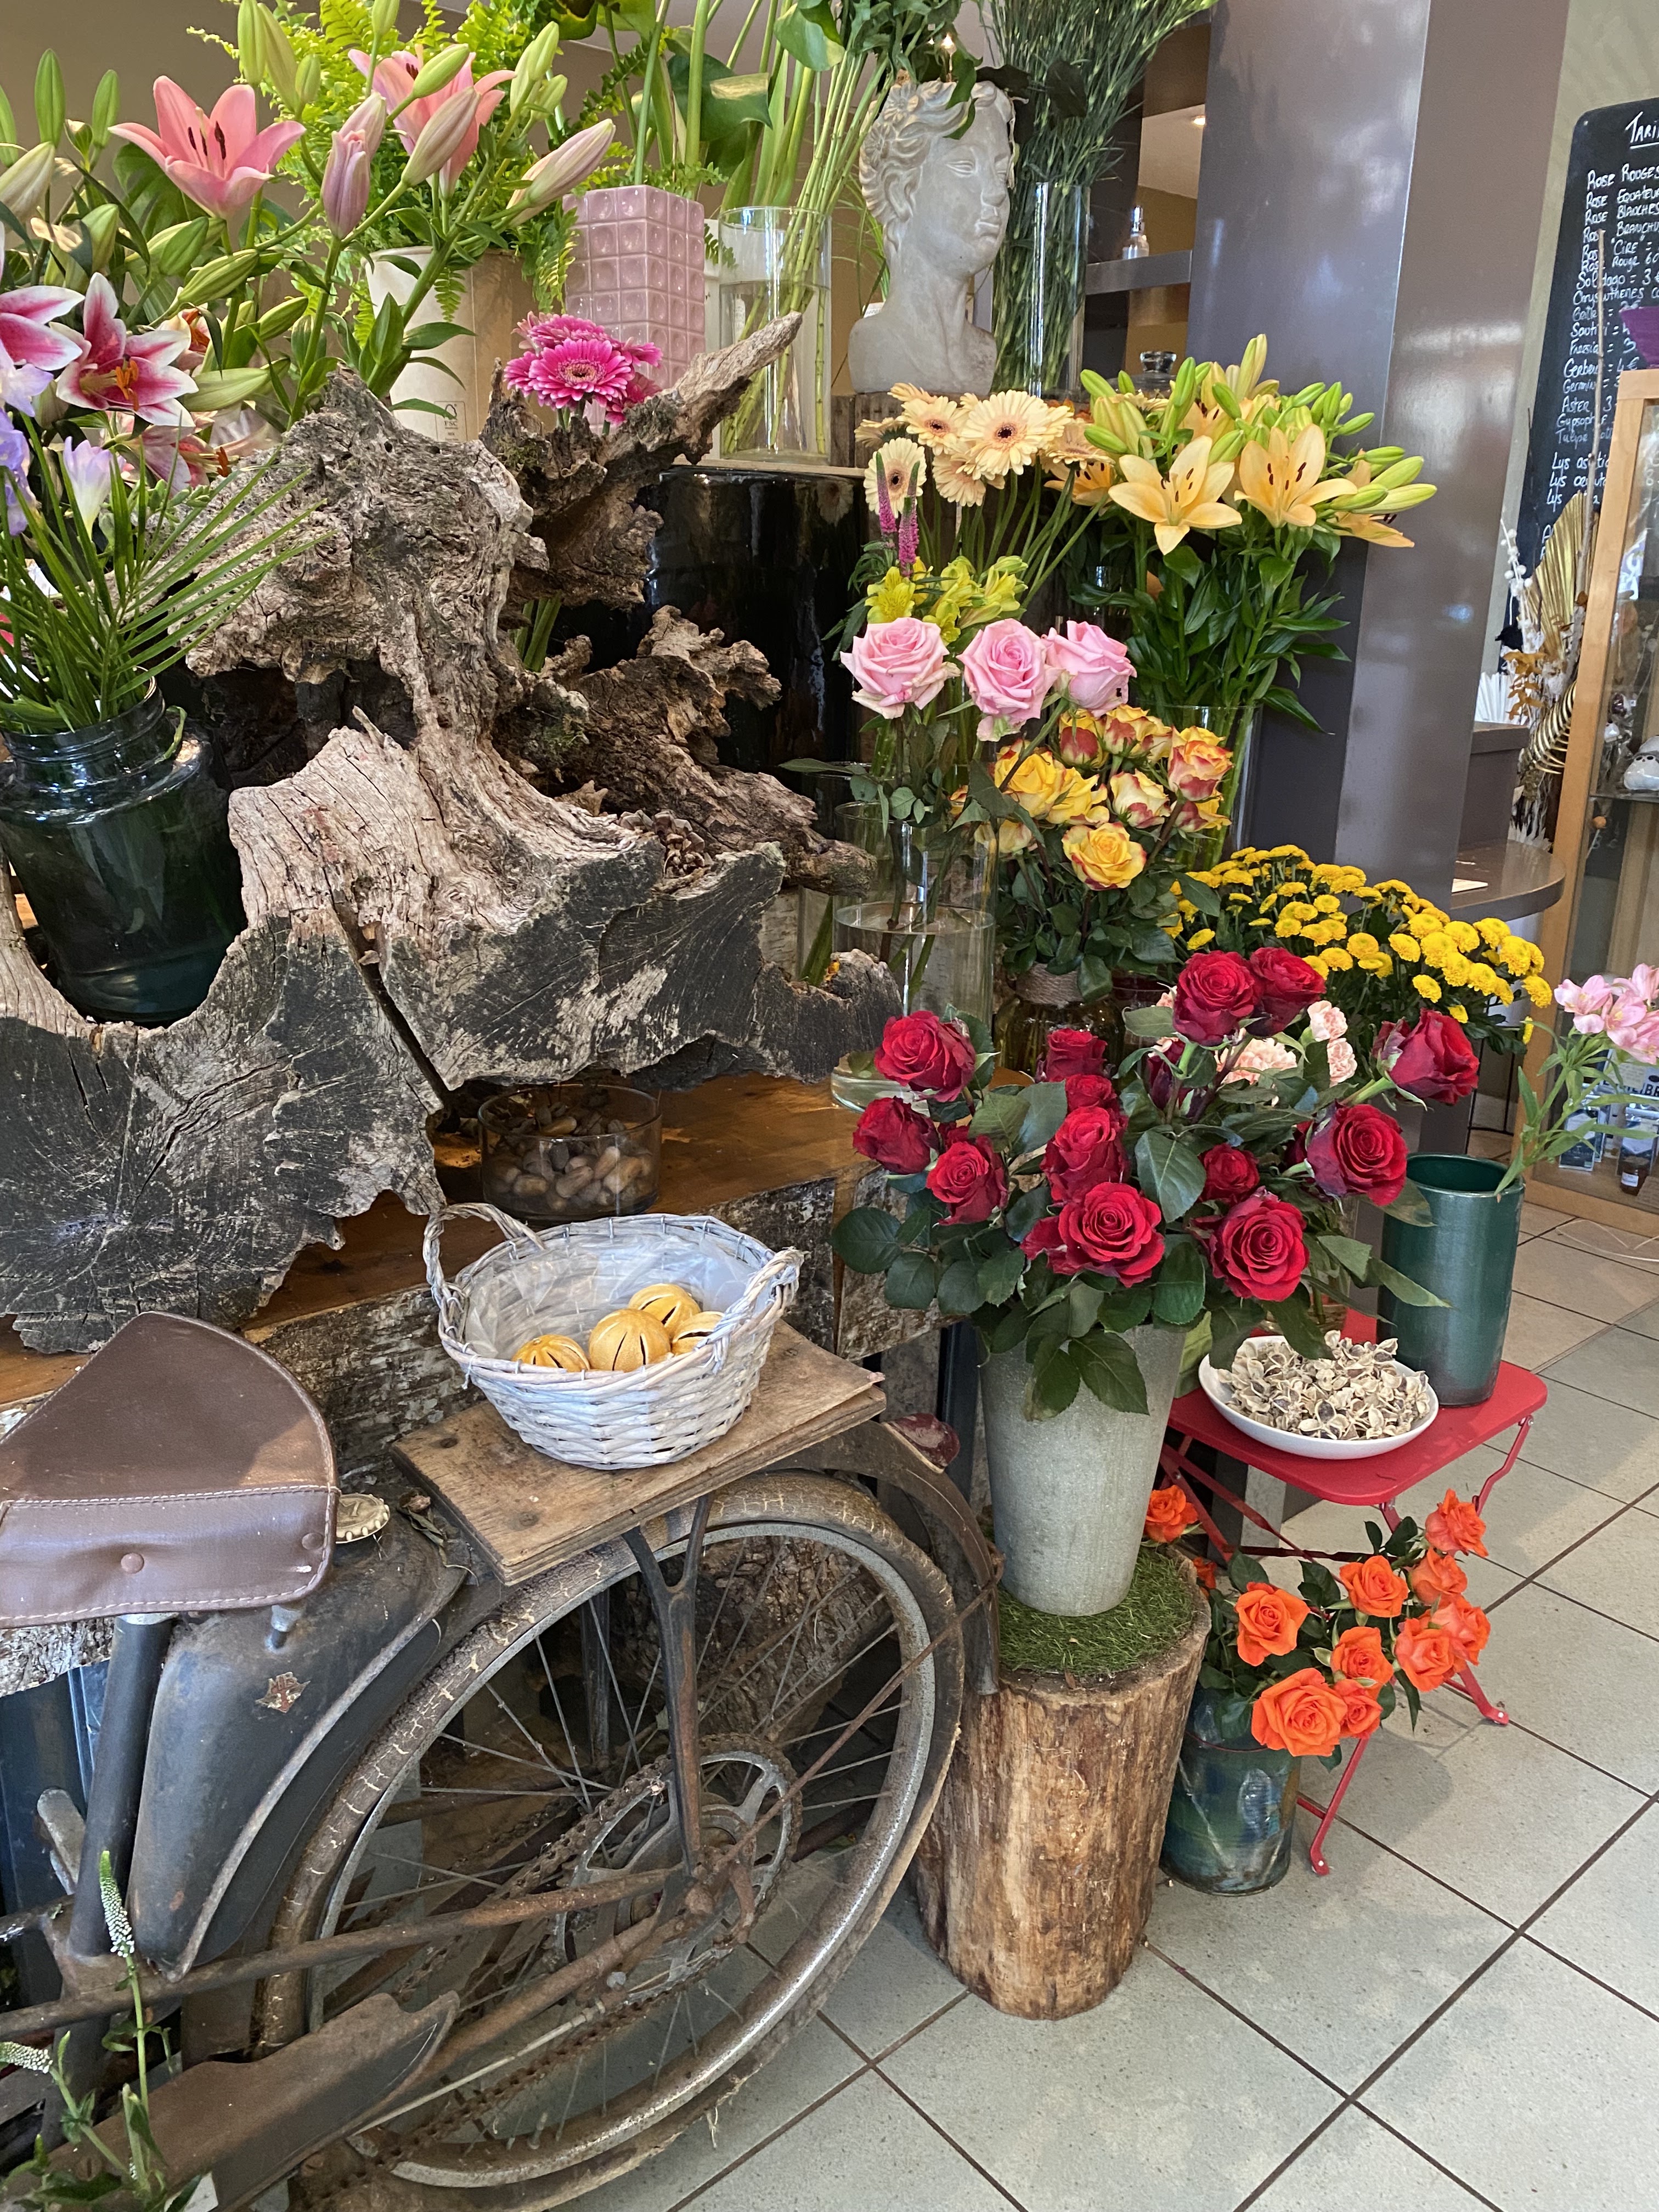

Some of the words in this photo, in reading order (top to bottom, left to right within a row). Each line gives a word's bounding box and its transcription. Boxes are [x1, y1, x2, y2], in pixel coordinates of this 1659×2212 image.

[1585, 208, 1609, 226] ROSE
[1583, 225, 1606, 243] ROS
[1642, 268, 1651, 285] 3
[1602, 395, 1612, 412] 3
